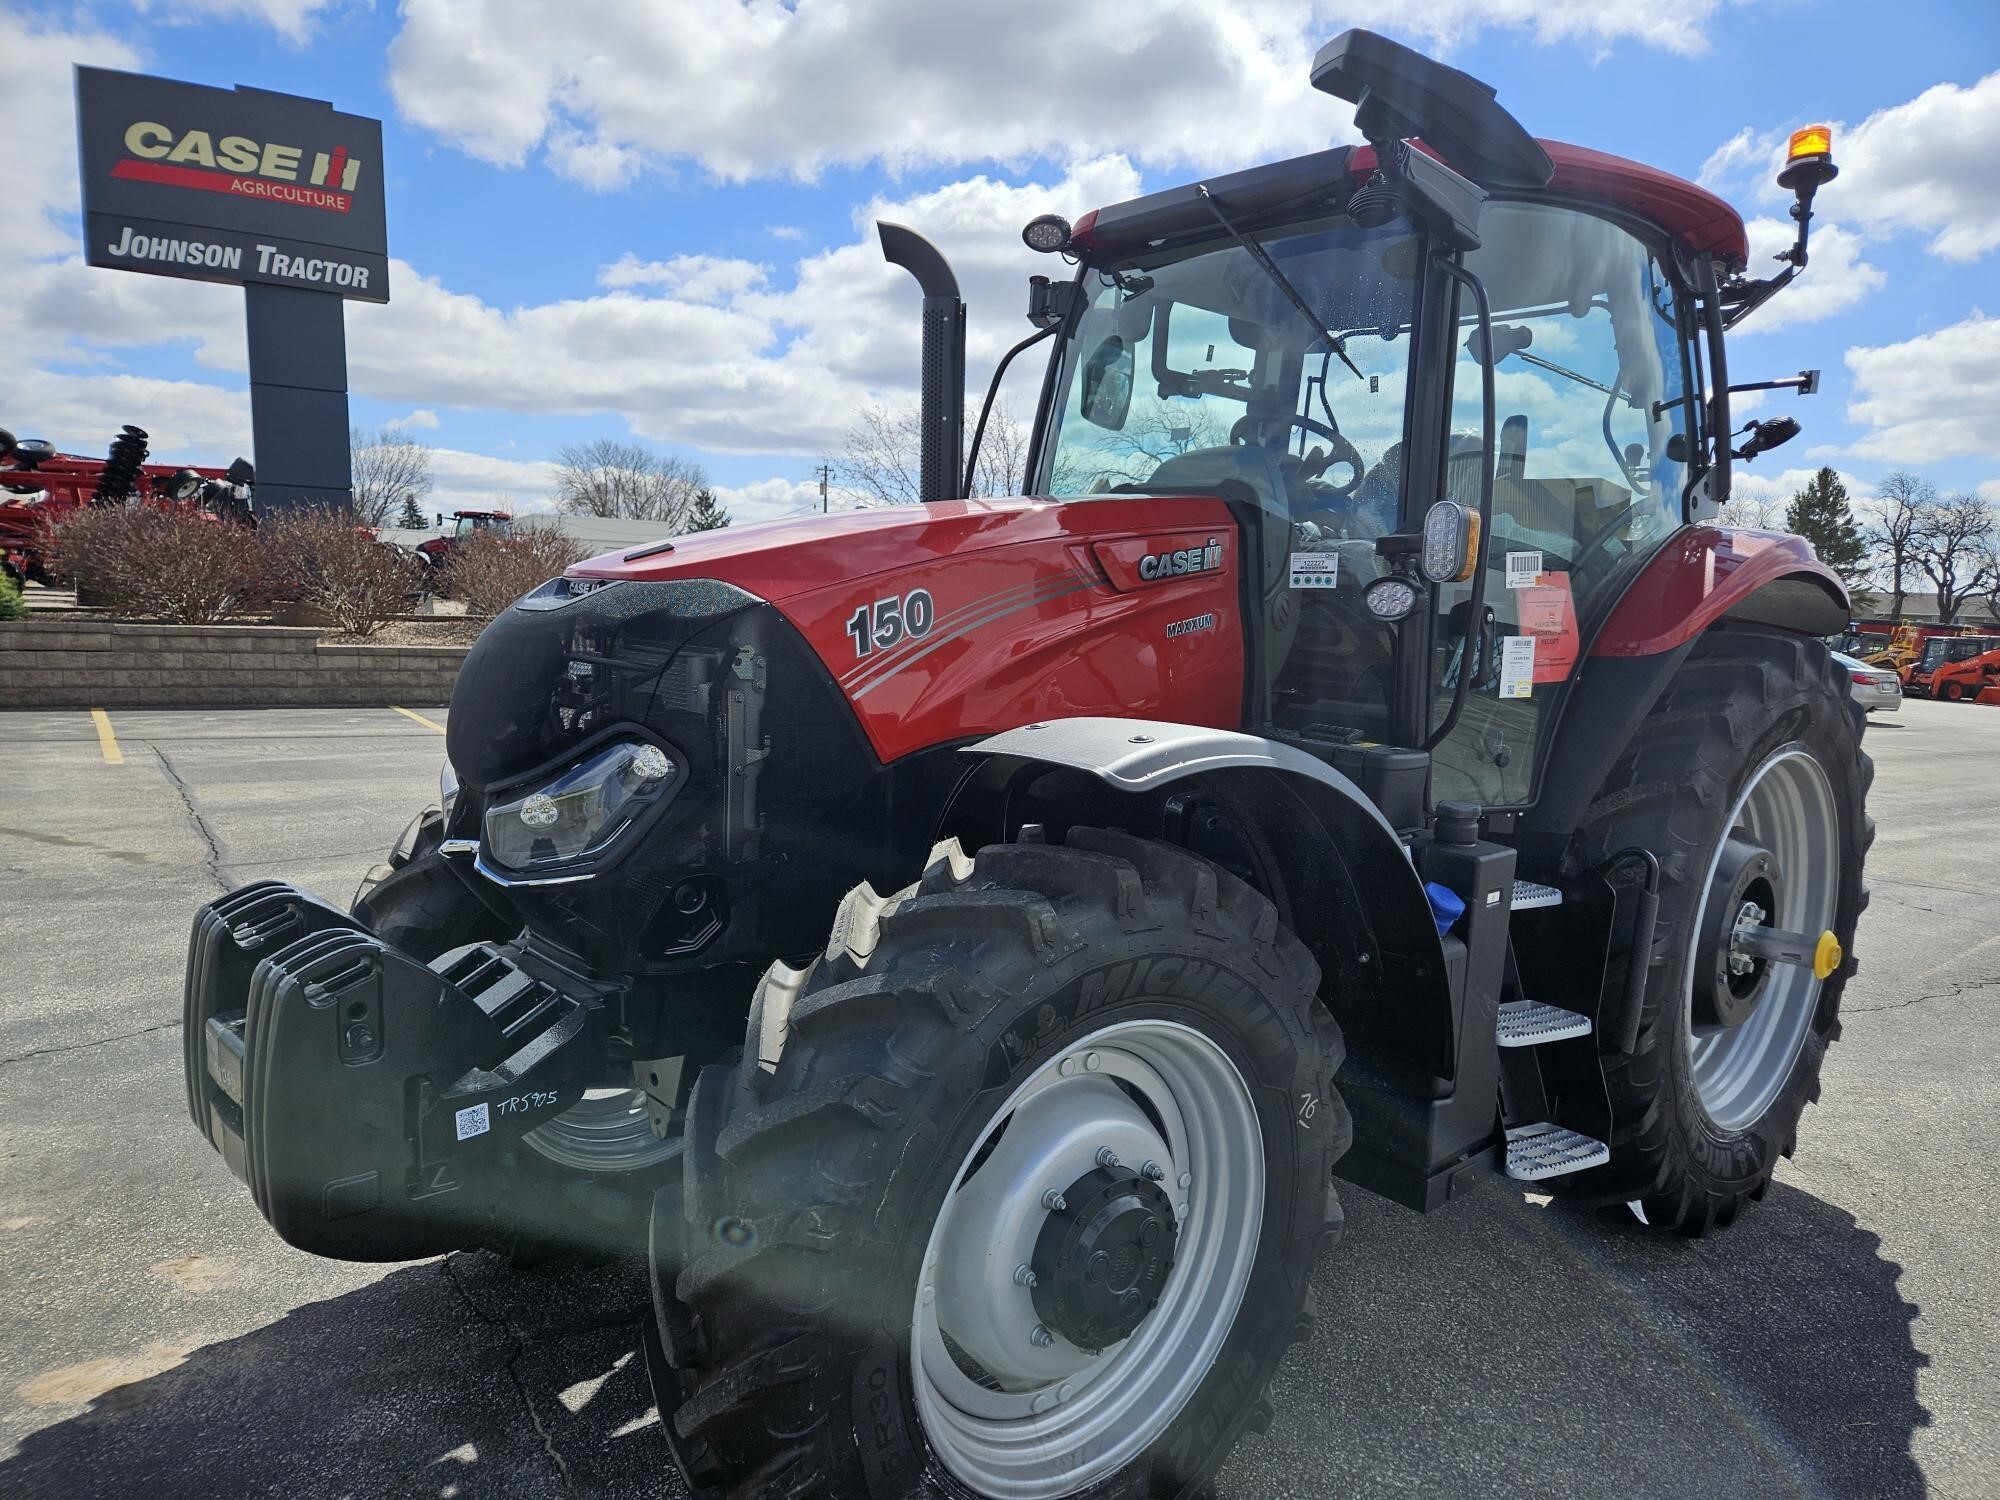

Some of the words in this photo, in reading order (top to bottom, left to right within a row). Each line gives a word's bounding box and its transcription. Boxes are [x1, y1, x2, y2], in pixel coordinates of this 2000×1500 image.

[124, 121, 303, 180] CASE
[230, 178, 346, 210] AGRICULTURE
[108, 226, 242, 270] JOHNSON
[255, 244, 370, 288] TRACTOR
[1139, 547, 1203, 581] CASE
[846, 588, 934, 659] 150
[1166, 613, 1213, 638] MAXXUM
[496, 1090, 558, 1116] TR5905
